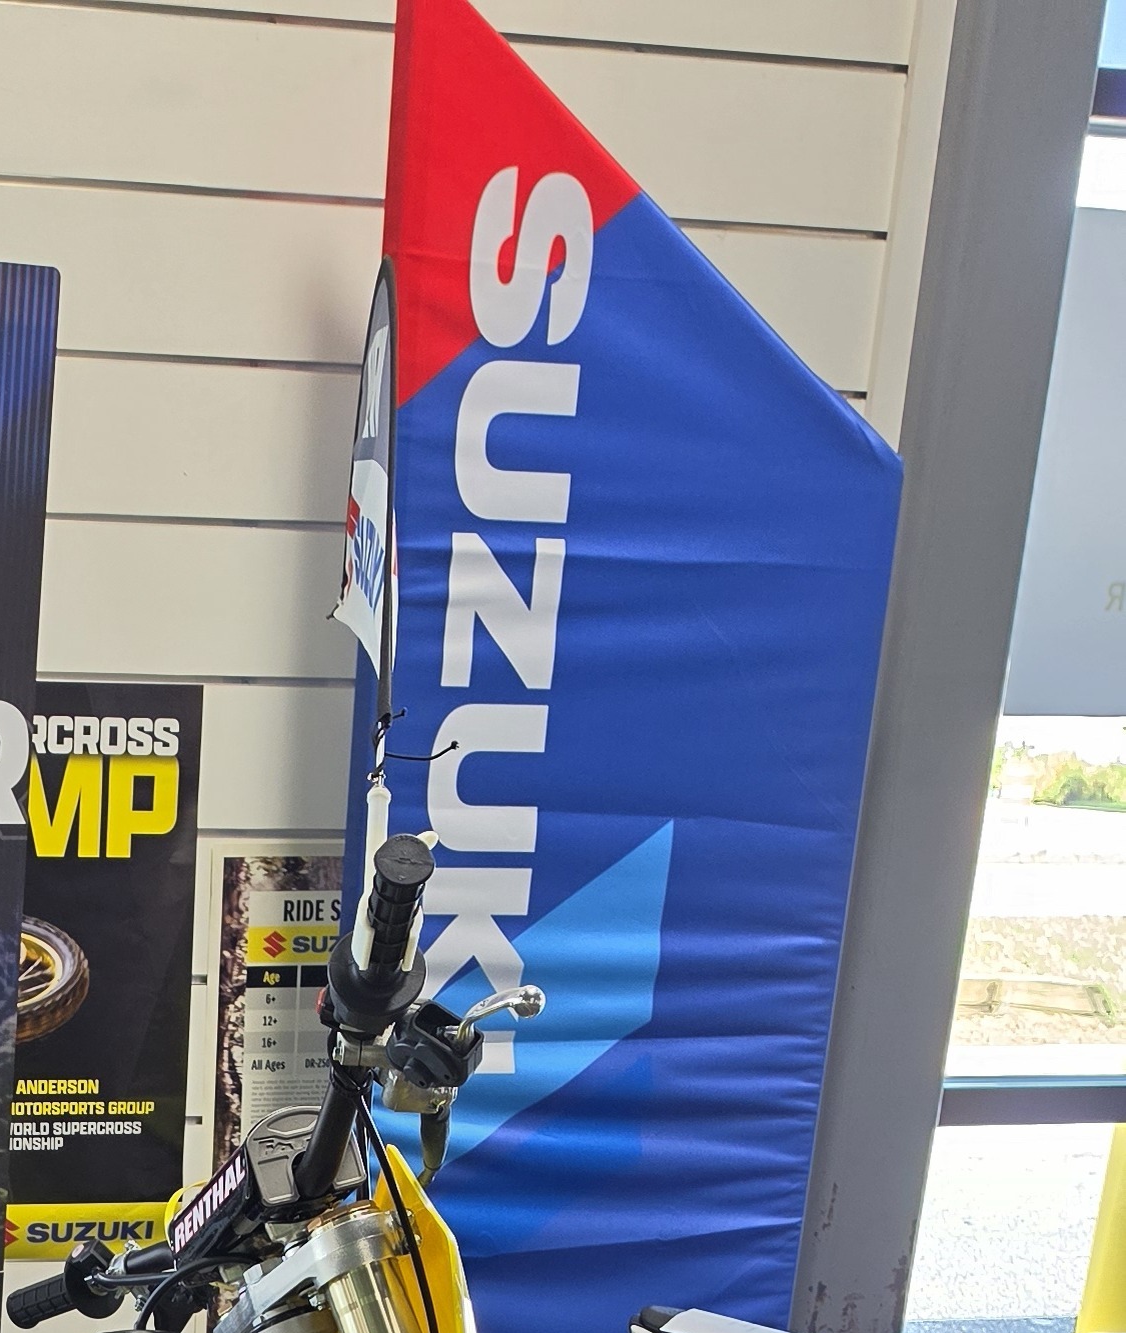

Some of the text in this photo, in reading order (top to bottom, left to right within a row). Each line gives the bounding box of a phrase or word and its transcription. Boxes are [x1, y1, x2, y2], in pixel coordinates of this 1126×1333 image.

[283, 900, 341, 922] RIDE S
[263, 971, 281, 985] Age
[263, 1015, 278, 1027] 12+
[262, 1037, 277, 1049] 16+
[251, 1059, 286, 1072] All Ages
[16, 1079, 100, 1095] ANDERSON
[11, 1101, 155, 1116] OTORSPORTS GROUP
[9, 1121, 142, 1136] ORLD SUPERCROSS
[174, 1153, 247, 1254] RENTHAL
[26, 1220, 155, 1243] SUZUKI
